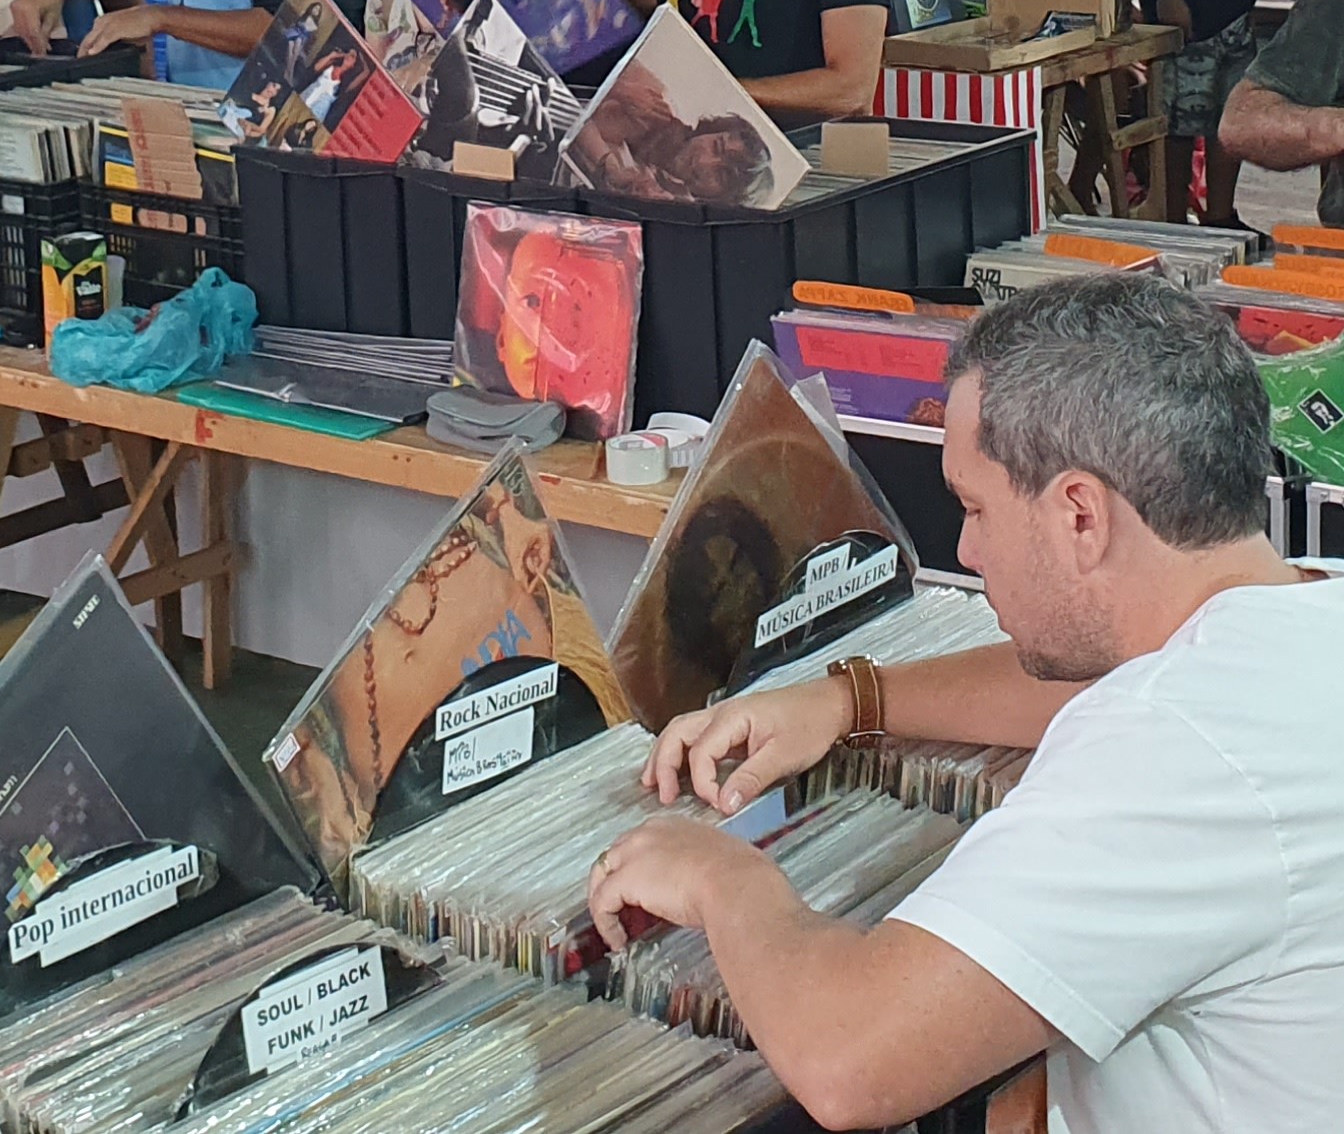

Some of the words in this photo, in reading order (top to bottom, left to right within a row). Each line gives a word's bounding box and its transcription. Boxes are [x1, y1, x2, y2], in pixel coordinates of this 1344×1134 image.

[971, 267, 1001, 284] SUZI
[758, 601, 813, 641] MÚSICA
[816, 558, 895, 612] BRASILEIRA
[809, 556, 840, 585] MPB
[440, 700, 480, 732] Rock
[485, 673, 554, 716] Nacional
[12, 920, 55, 951] Pop
[60, 852, 195, 930] internacional
[257, 995, 304, 1027] SOUL
[316, 962, 372, 1000] BLACK
[267, 1020, 316, 1055] FUNK
[329, 994, 370, 1027] JAZZ
